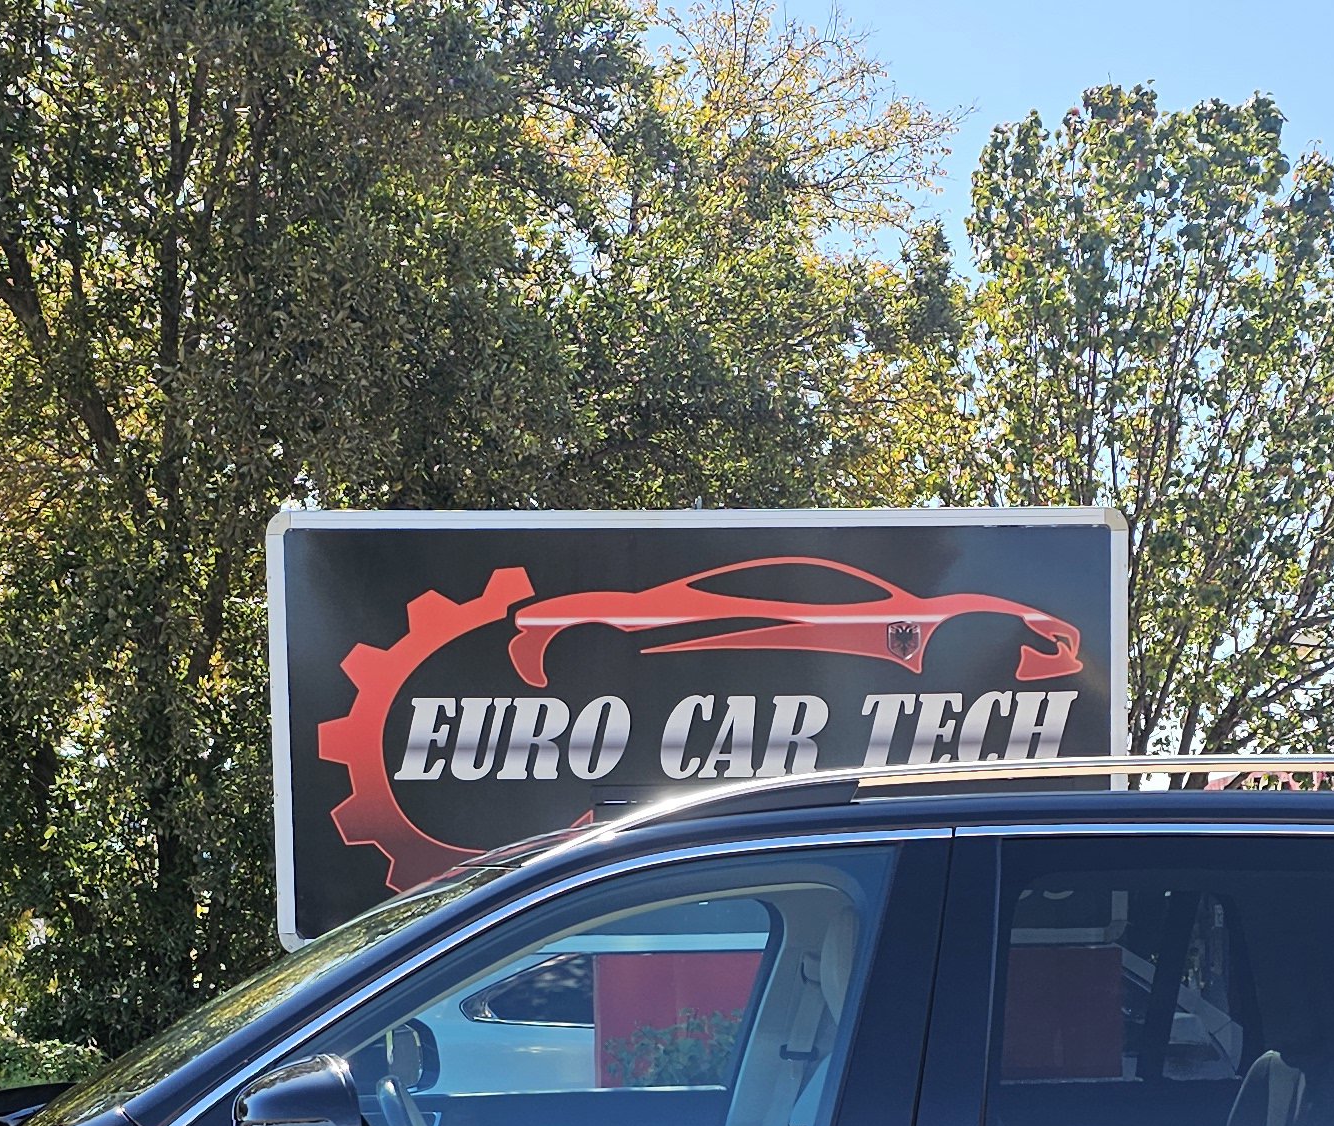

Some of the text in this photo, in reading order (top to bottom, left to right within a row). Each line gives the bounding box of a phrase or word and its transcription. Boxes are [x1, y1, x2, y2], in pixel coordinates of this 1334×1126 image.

[393, 690, 1079, 781] EURO CAR TECH
